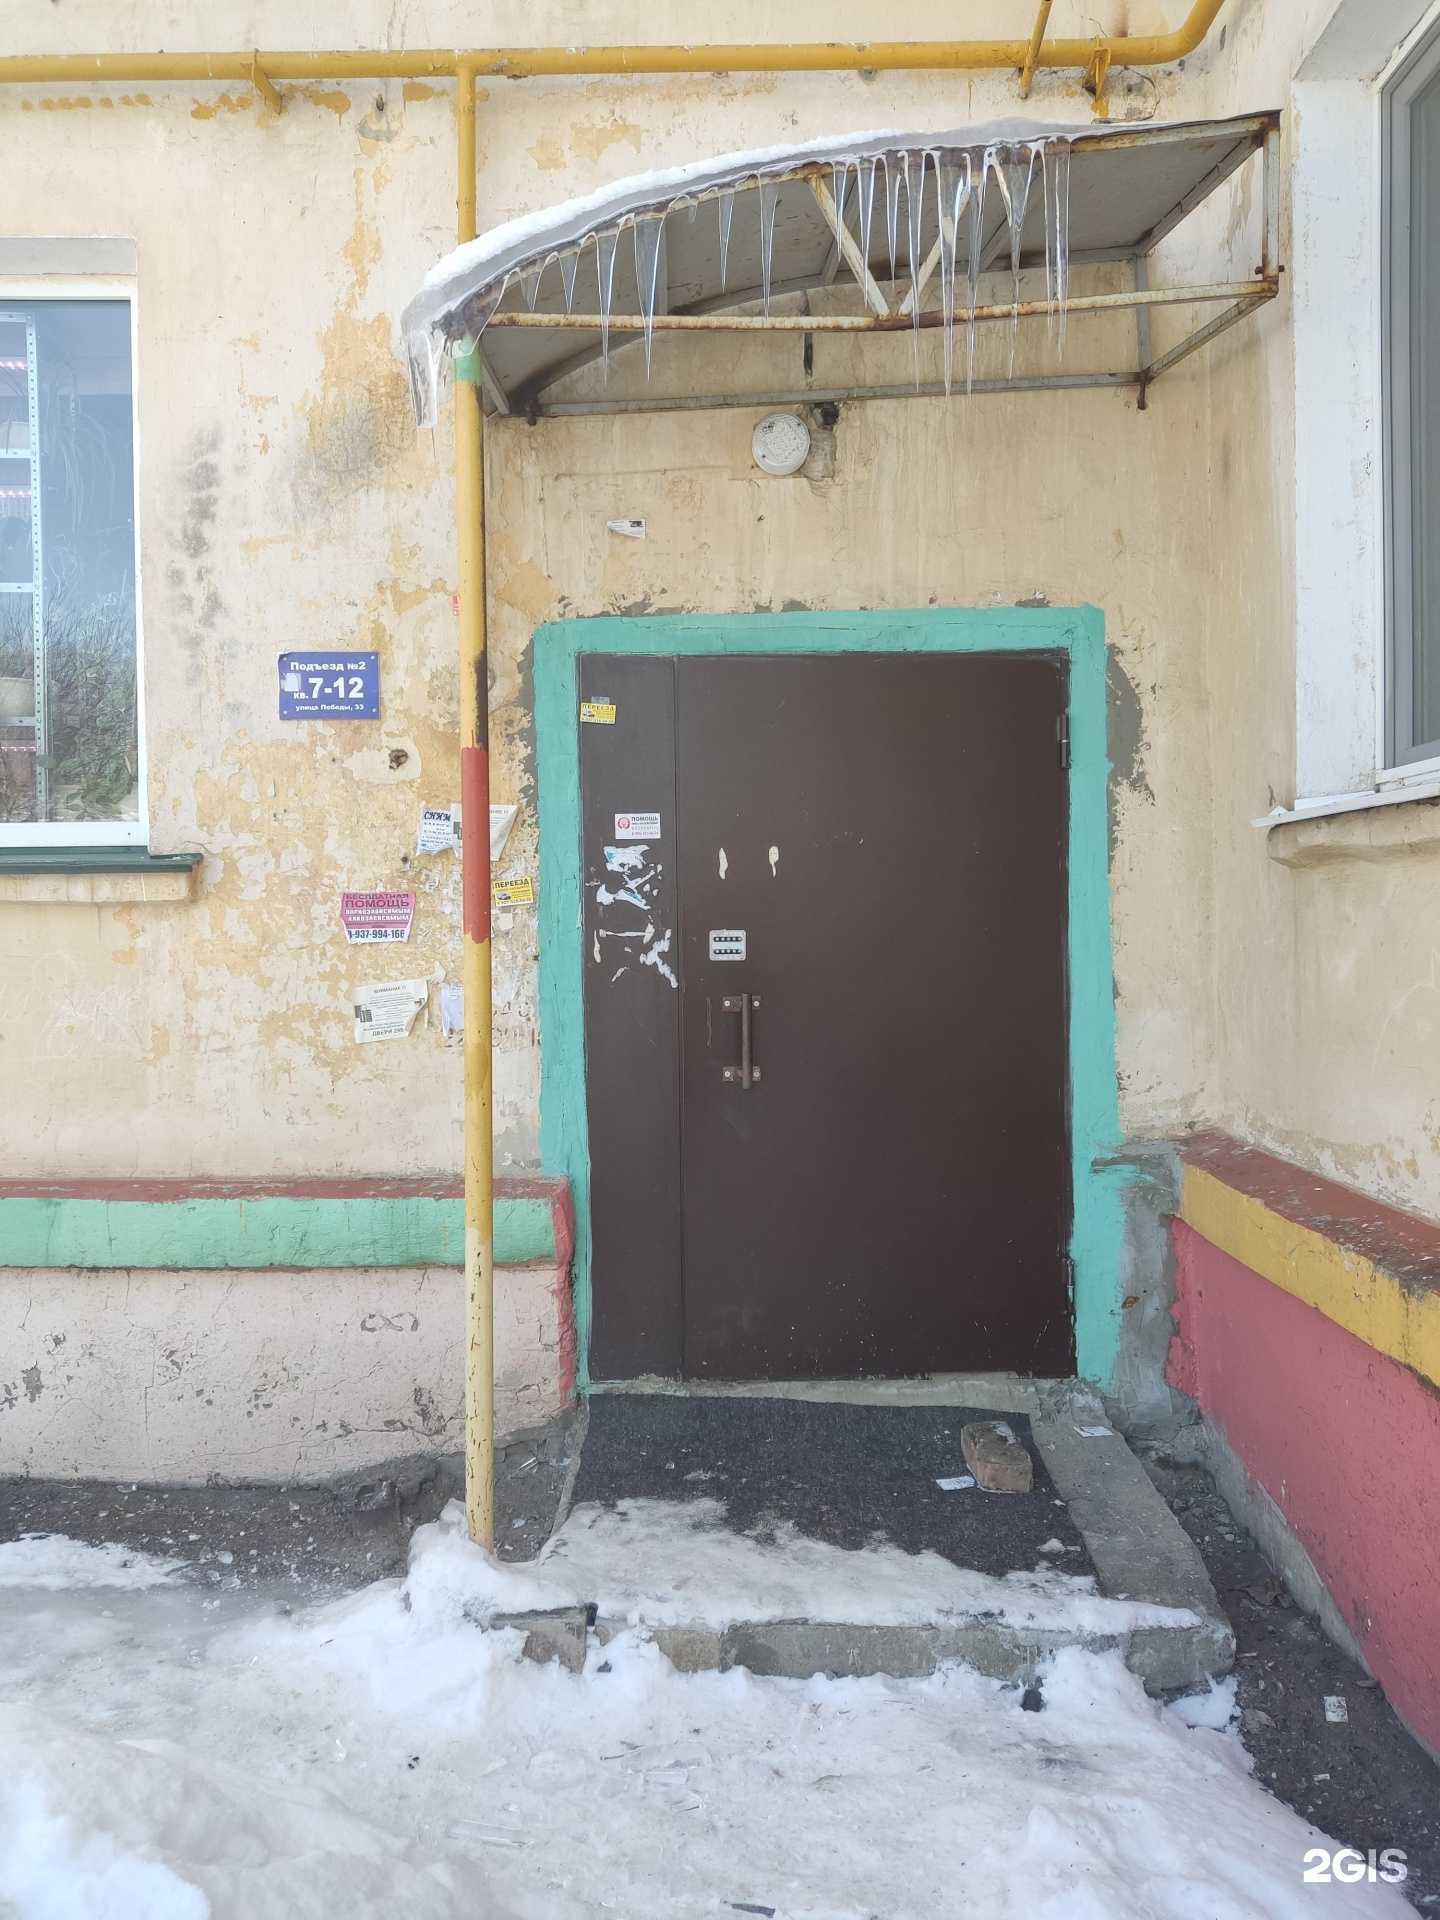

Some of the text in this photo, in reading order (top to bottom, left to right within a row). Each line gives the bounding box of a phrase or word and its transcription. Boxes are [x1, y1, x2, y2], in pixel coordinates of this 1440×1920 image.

[290, 661, 367, 671] Подъезд №2
[308, 676, 364, 699] 7-12
[494, 878, 529, 888] ПЕРЕЕЗД
[345, 900, 410, 908] ПОМОЩЬ
